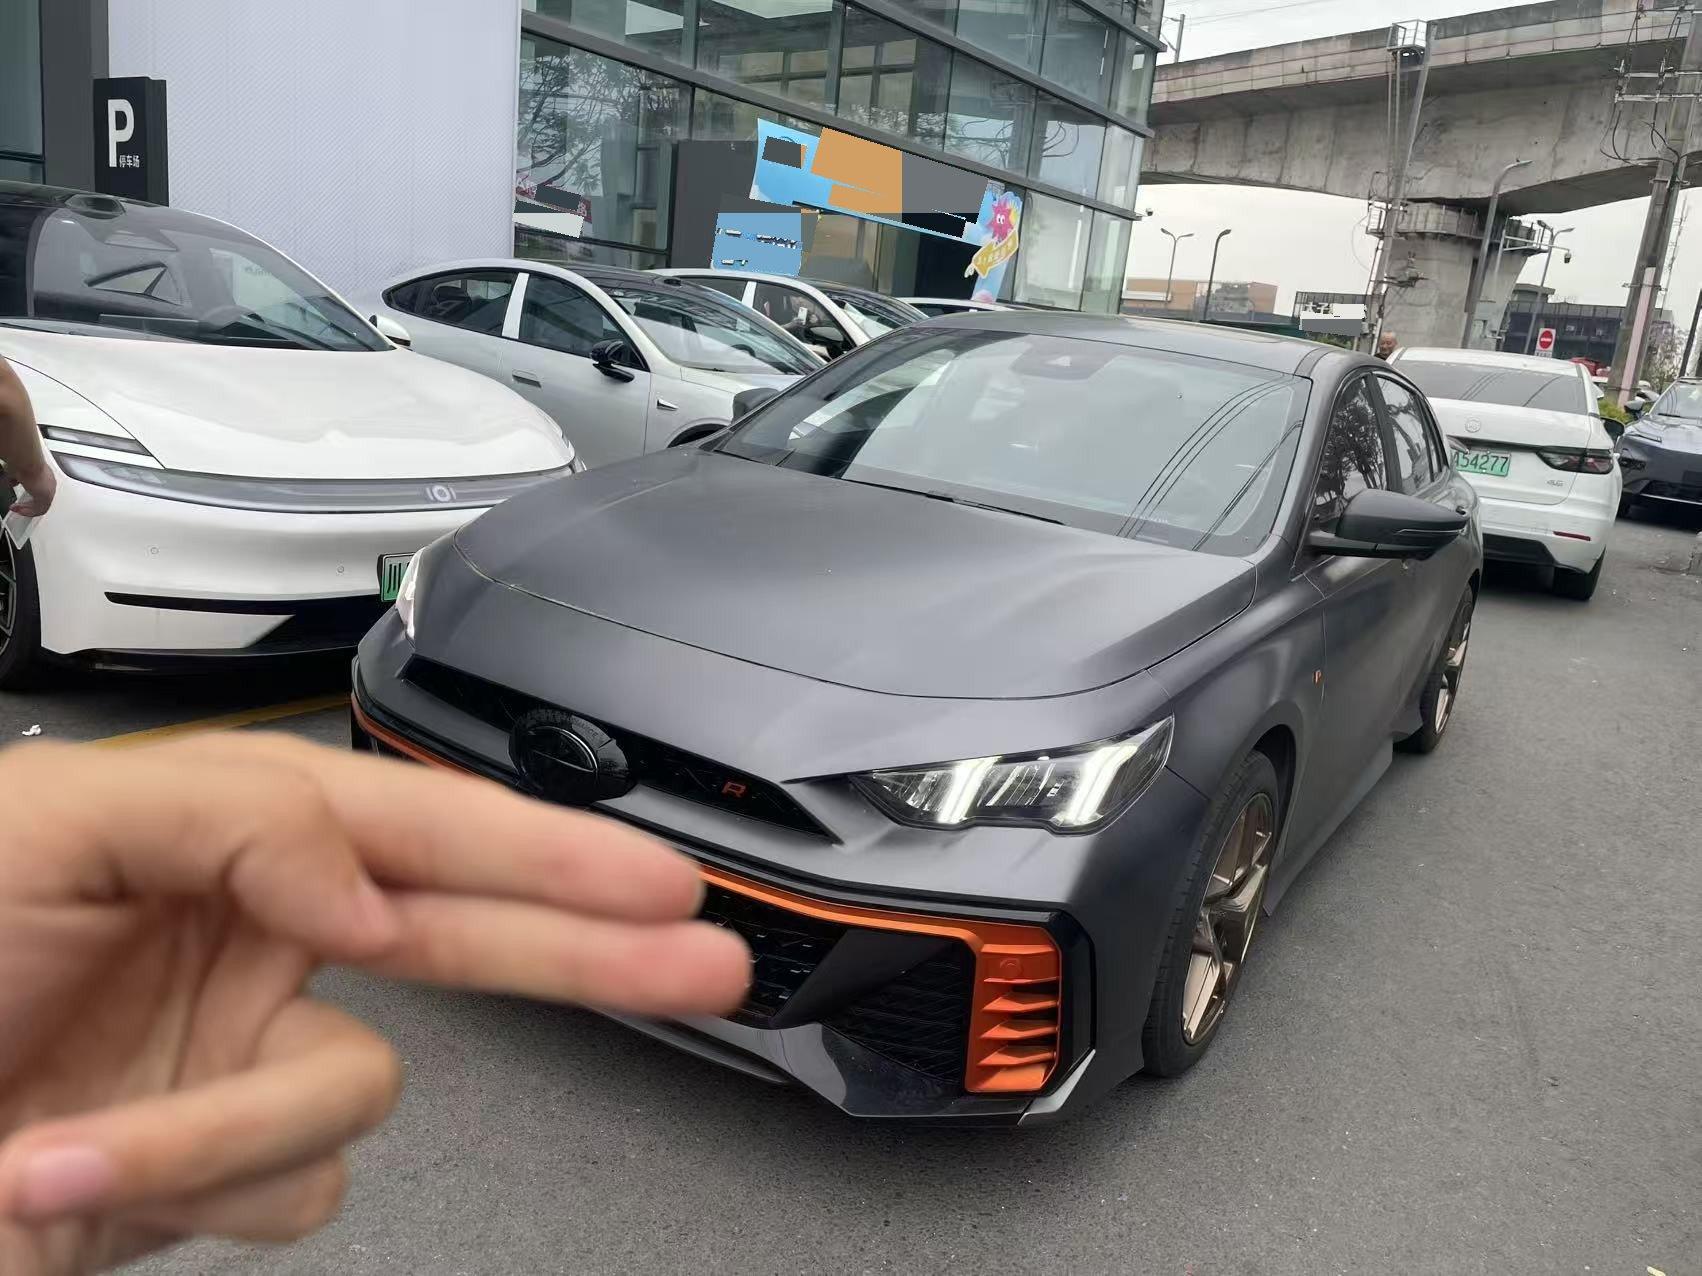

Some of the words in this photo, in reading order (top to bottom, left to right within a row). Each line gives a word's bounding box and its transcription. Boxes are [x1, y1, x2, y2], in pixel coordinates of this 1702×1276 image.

[107, 98, 135, 167] P
[119, 154, 140, 168] 停车场
[721, 781, 747, 798] R
